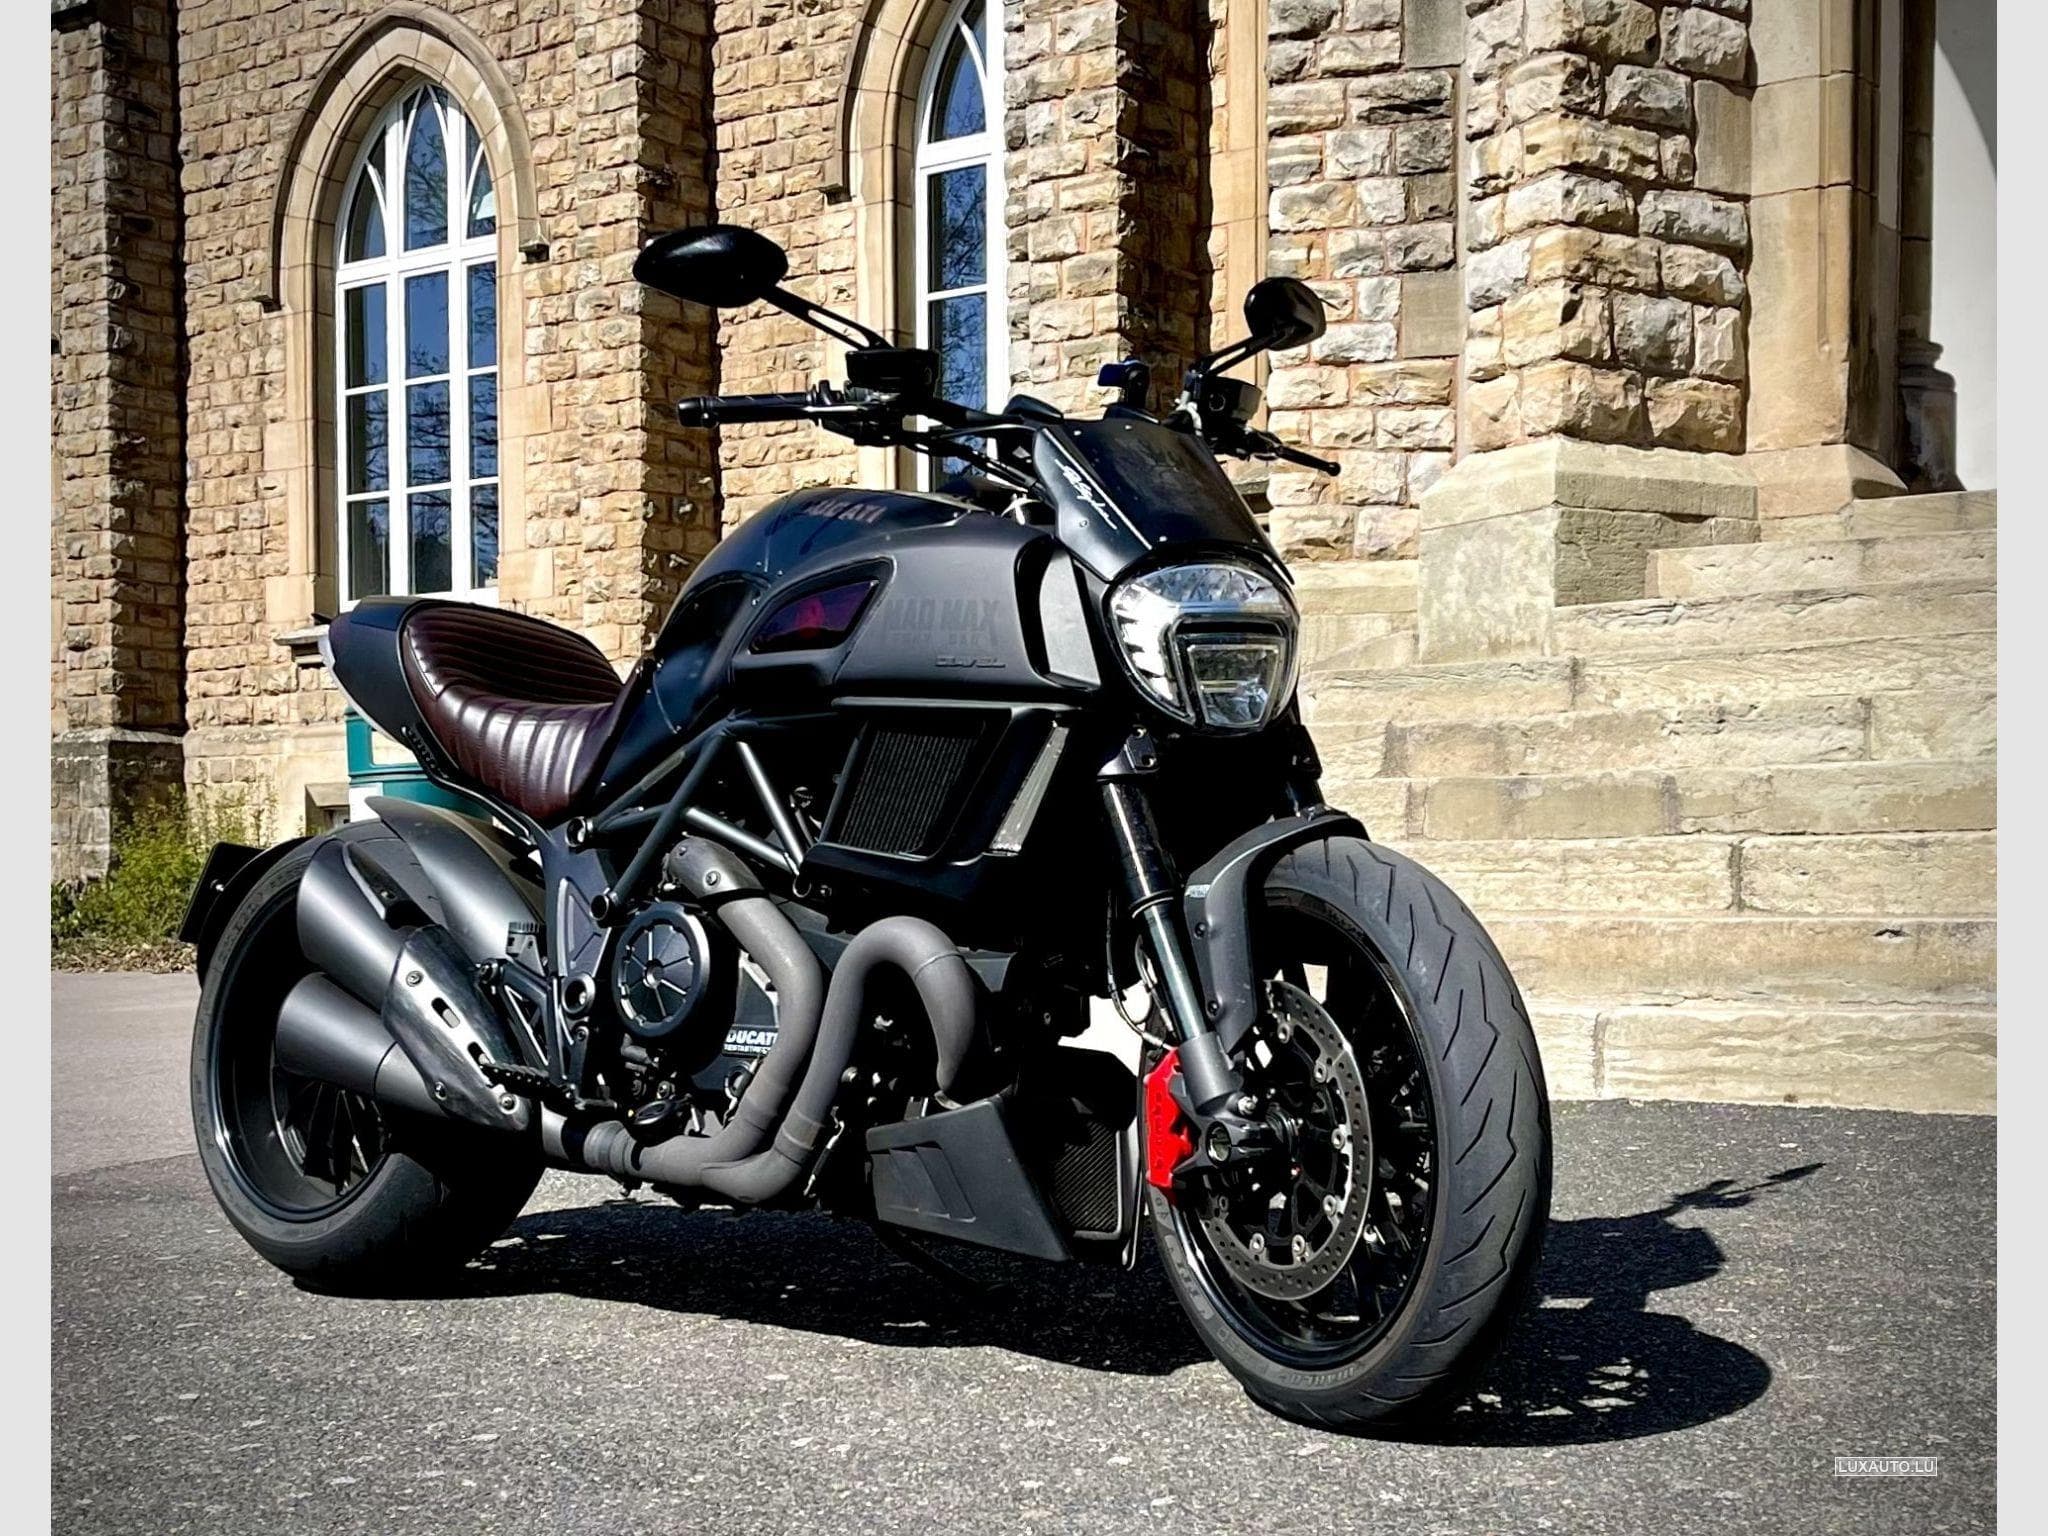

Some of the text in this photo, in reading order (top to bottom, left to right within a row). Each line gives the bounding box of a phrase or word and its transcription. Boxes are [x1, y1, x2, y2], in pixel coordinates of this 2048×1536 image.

[885, 598, 1000, 646] MAD MAX
[725, 1029, 779, 1046] DUCATI
